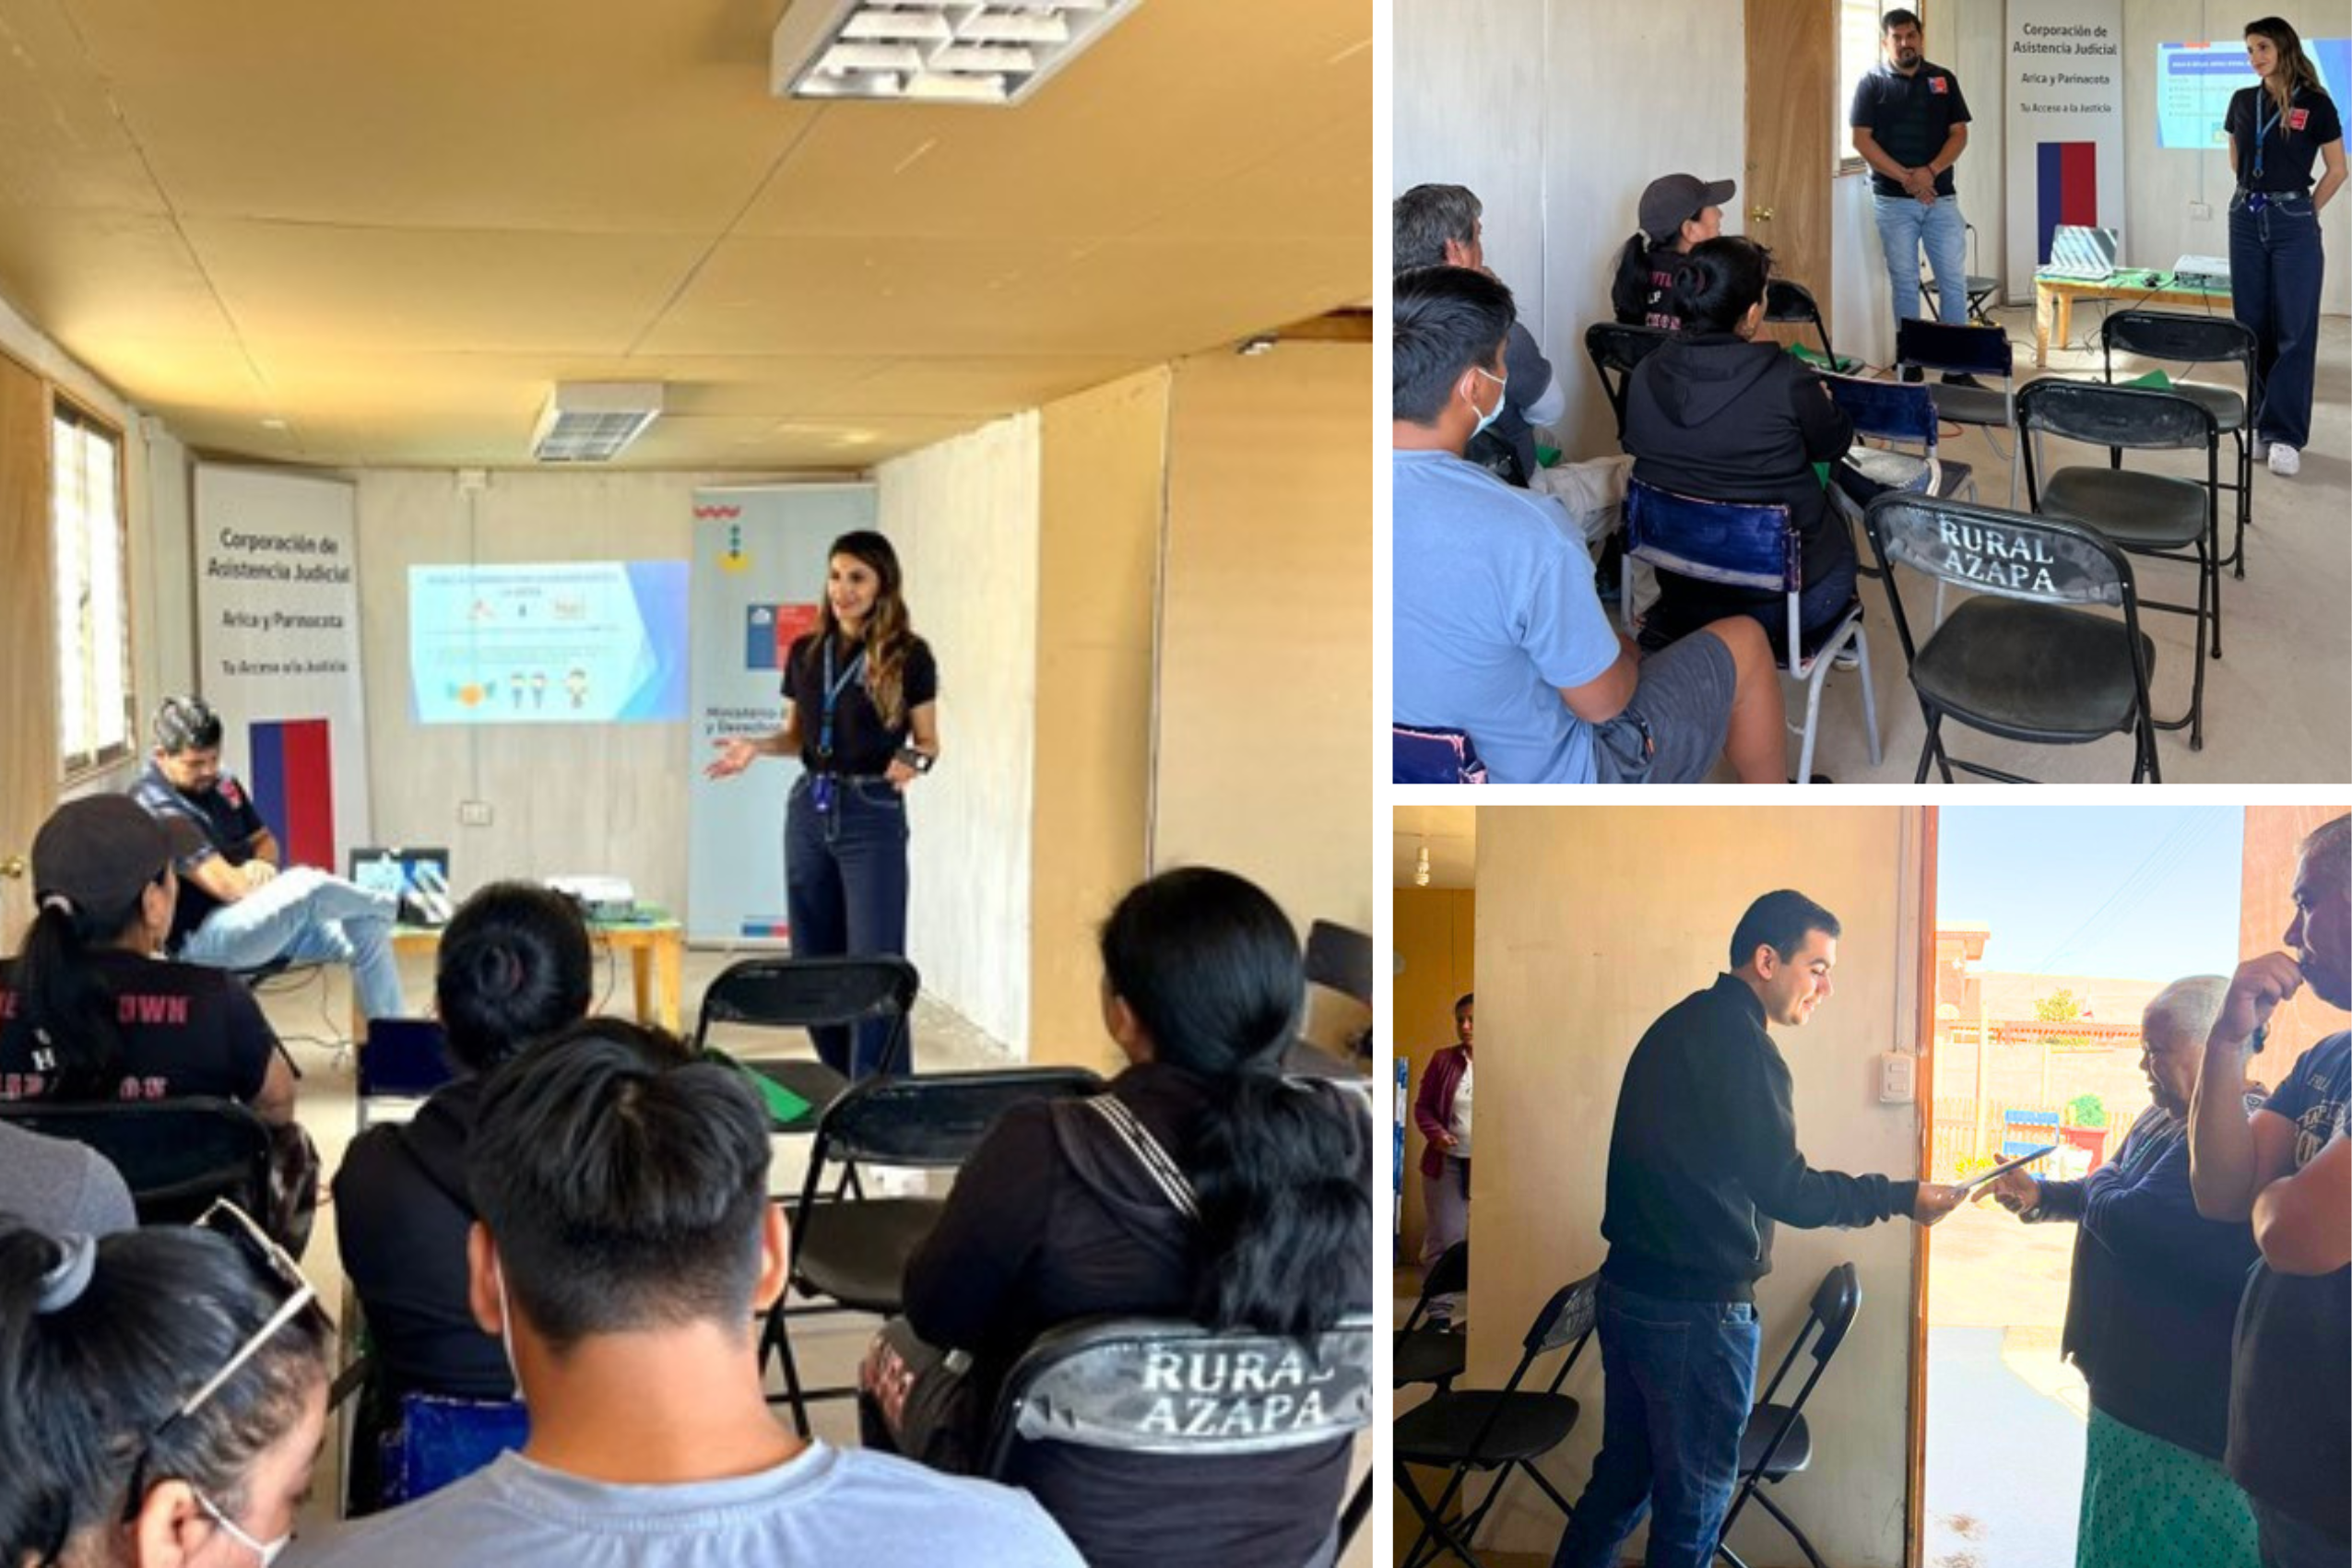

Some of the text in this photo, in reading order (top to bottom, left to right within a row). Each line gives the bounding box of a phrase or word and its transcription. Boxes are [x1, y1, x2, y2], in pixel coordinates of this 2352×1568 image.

[2023, 22, 2108, 37] Corporación de
[2013, 41, 2118, 55] Asistencia Judicial
[2021, 73, 2110, 87] Arica y Parinacota
[2020, 102, 2031, 112] Tu
[2032, 102, 2061, 113] Acceso
[2070, 103, 2078, 112] la
[2080, 103, 2112, 113] Justicia
[219, 526, 338, 554] Corporación de
[1939, 518, 2054, 564] RURAL
[207, 556, 351, 583] Asistencia Judicial
[1944, 550, 2056, 593] AZAPA
[222, 610, 258, 628] Arica
[1136, 1389, 1328, 1438] AZAPA
